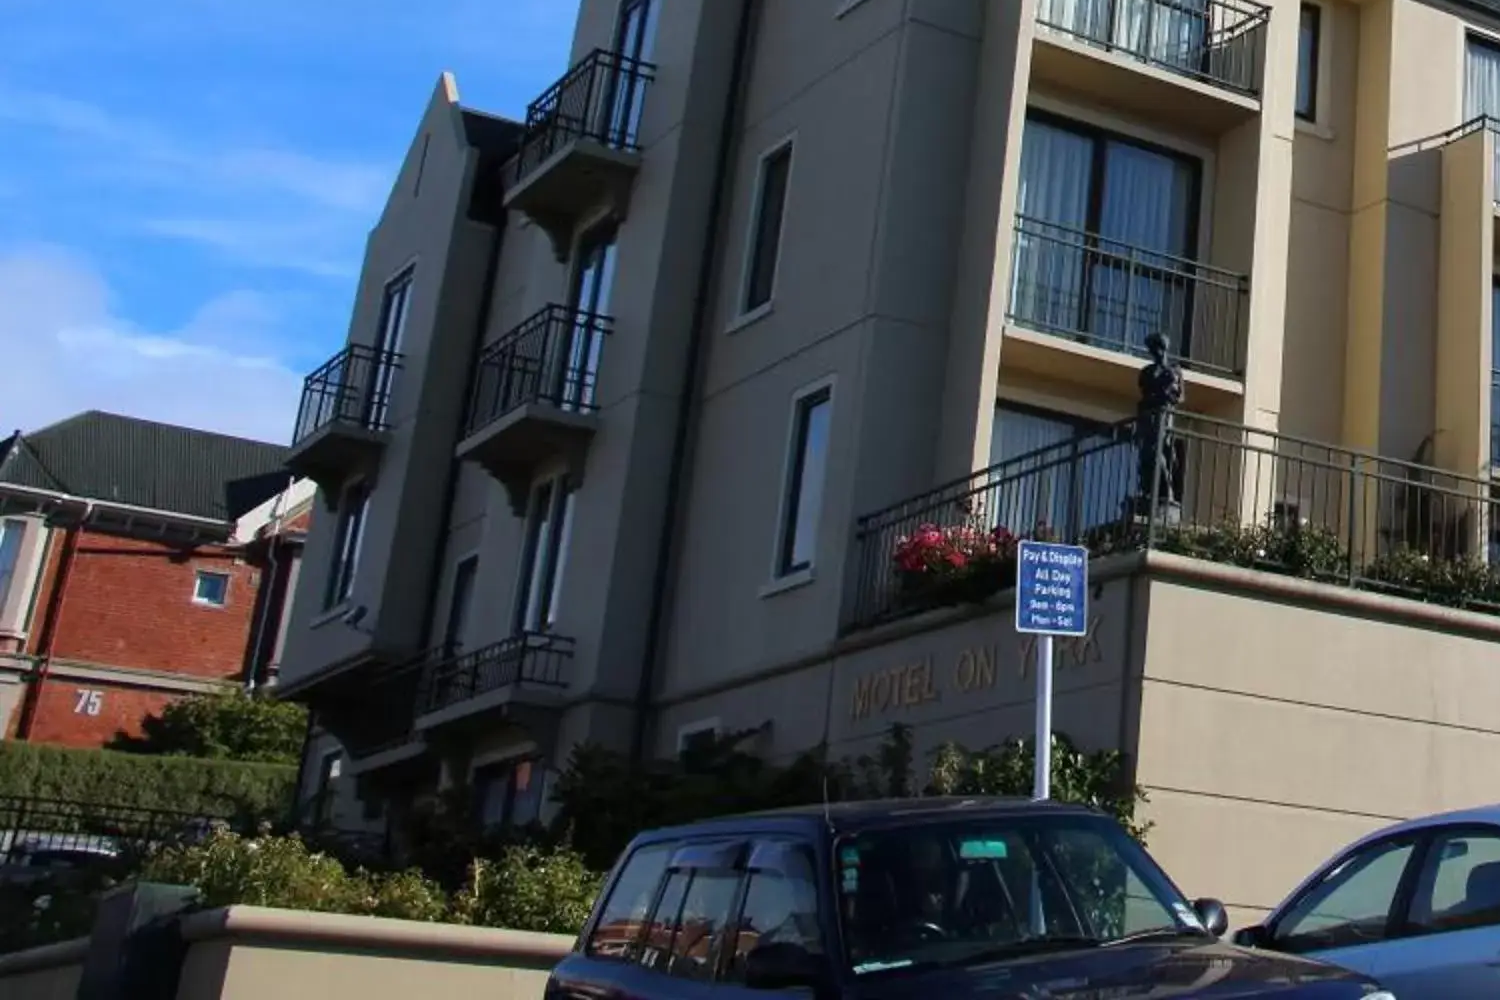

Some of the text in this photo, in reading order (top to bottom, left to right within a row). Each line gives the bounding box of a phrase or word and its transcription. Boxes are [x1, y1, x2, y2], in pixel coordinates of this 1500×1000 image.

[1023, 548, 1040, 563] Pay
[1049, 551, 1083, 568] Display
[1035, 567, 1071, 584] All Day
[1034, 583, 1071, 598] Parking
[851, 615, 1103, 720] MOTEL ON YRK
[74, 688, 104, 716] 75
